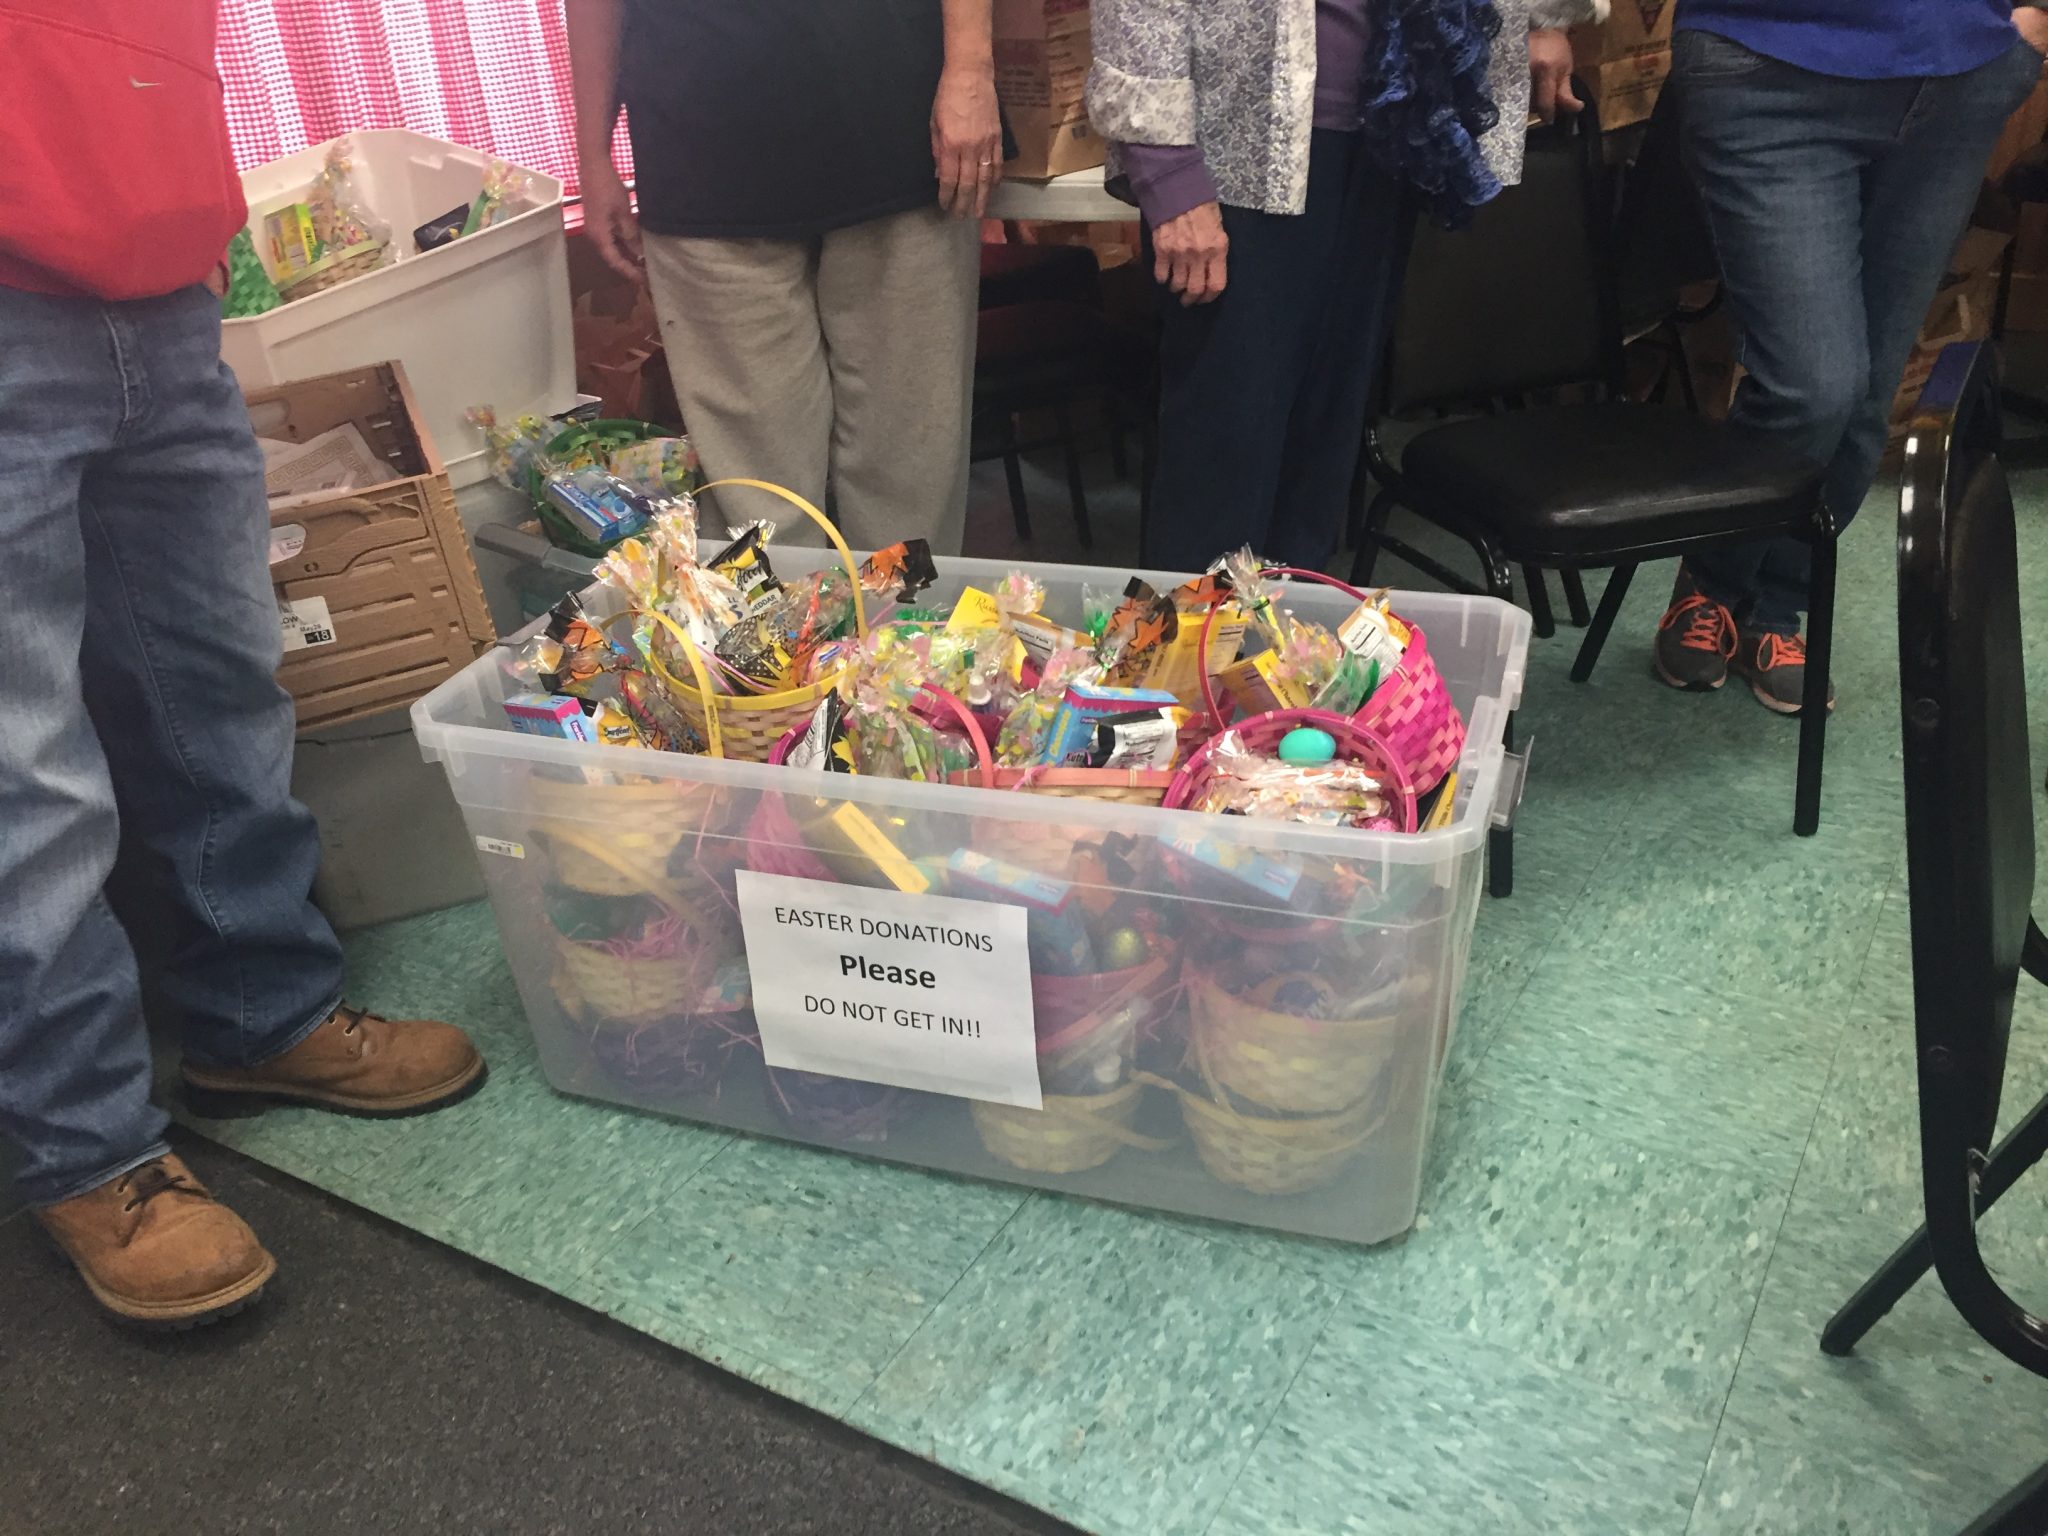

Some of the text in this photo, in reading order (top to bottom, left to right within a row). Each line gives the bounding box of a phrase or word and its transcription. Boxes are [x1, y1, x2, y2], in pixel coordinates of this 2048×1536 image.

[775, 906, 993, 953] EASTER DONATIONS
[839, 954, 936, 989] Please
[804, 995, 981, 1039] DO NOT GET IN!!
